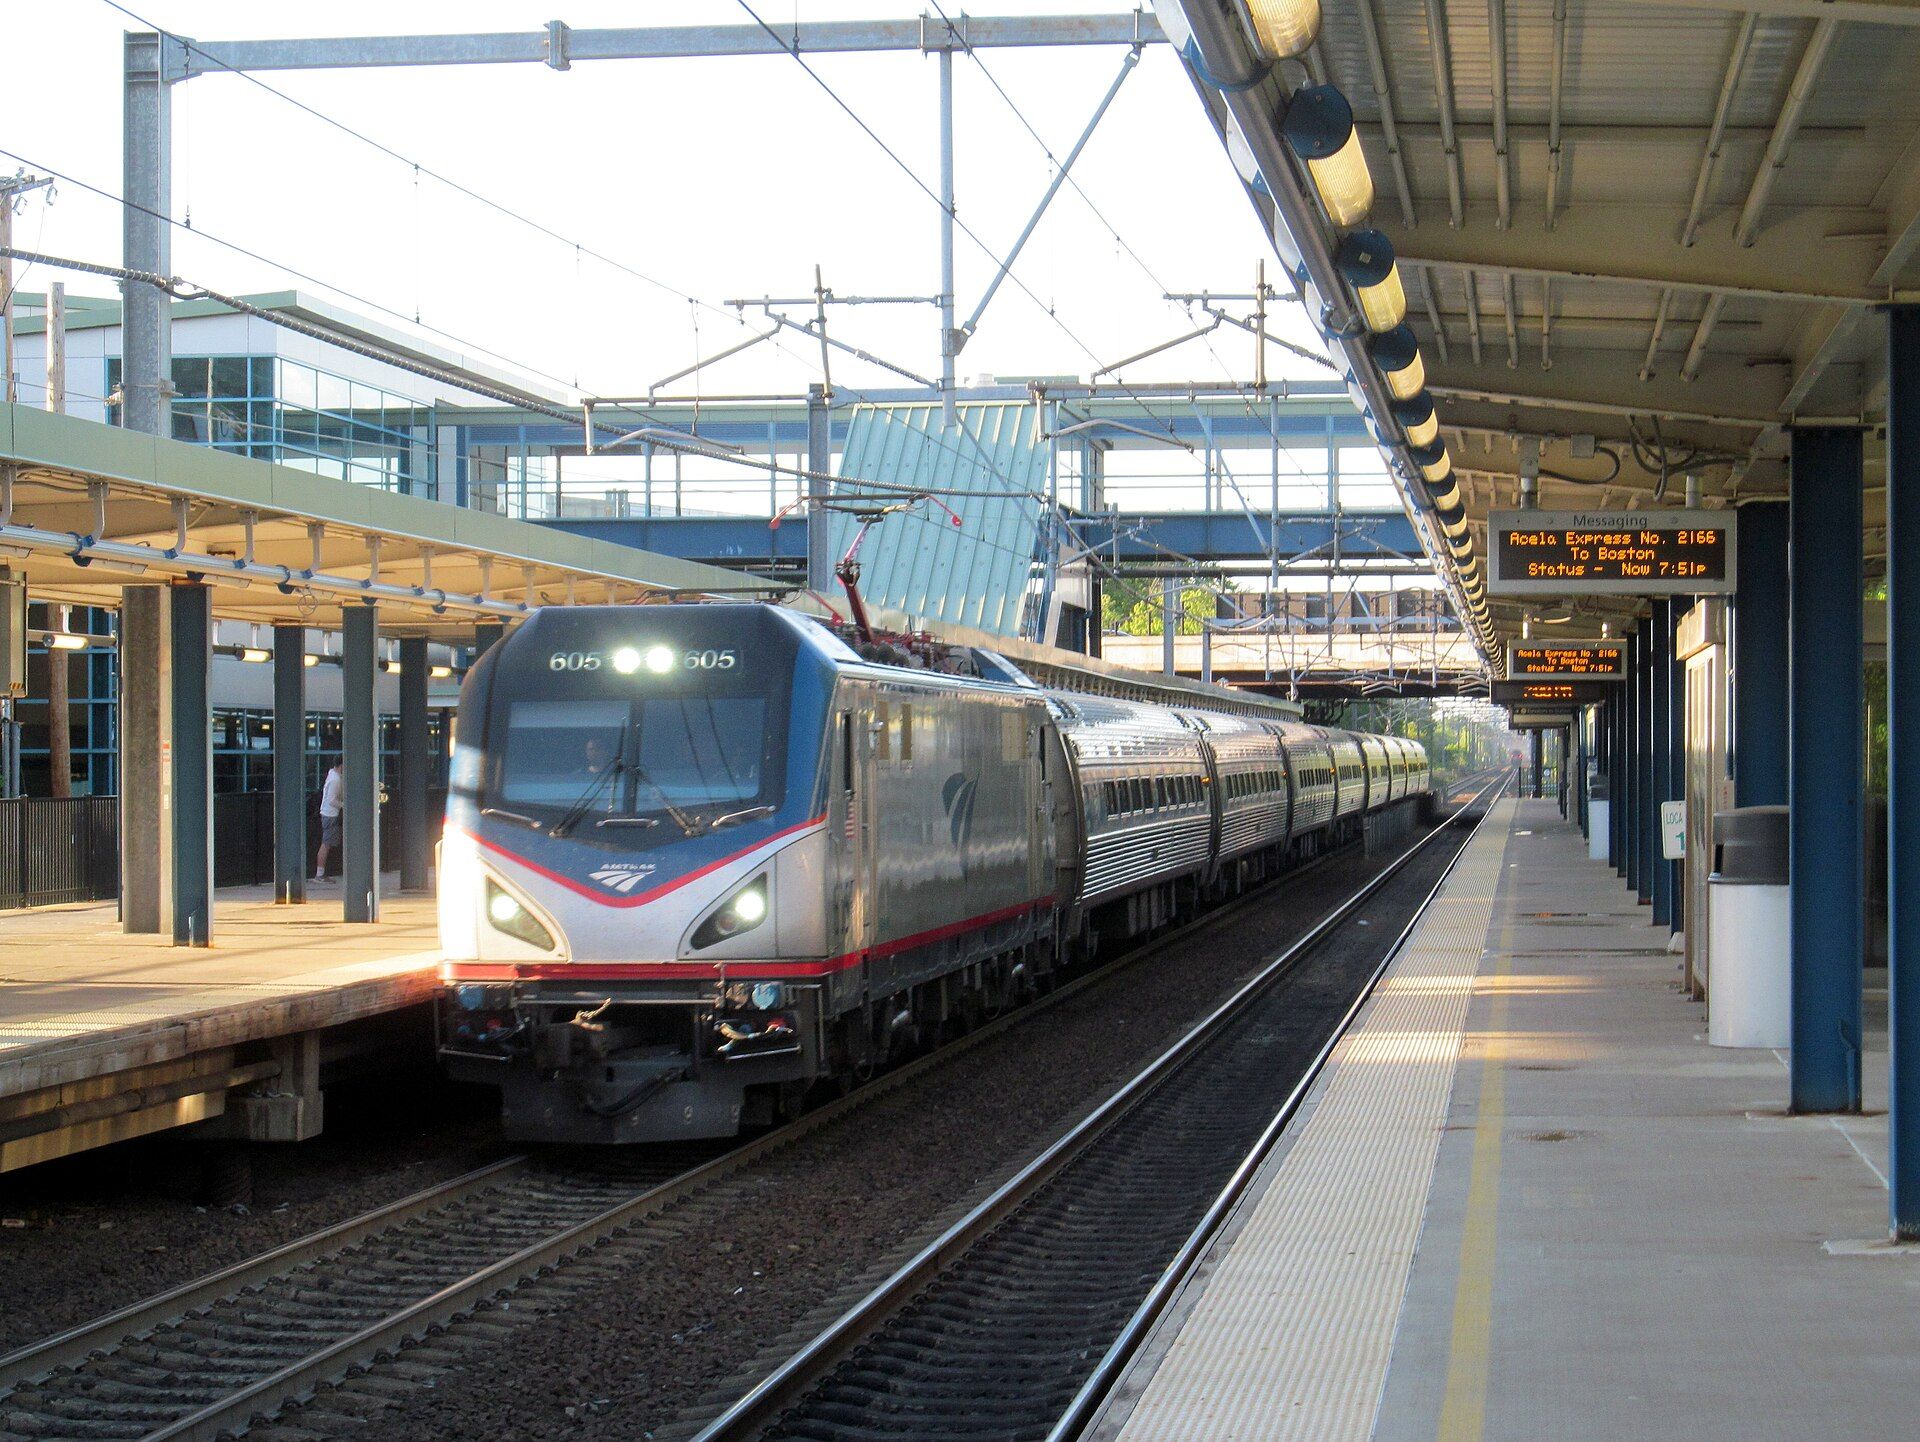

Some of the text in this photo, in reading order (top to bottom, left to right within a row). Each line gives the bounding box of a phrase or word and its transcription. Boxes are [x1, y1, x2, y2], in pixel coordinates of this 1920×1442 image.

[1573, 514, 1648, 529] Messaging
[1510, 531, 1716, 545] Acela Express No. 2166
[1571, 547, 1655, 560] To Boston
[1528, 563, 1585, 576] Status
[1621, 563, 1650, 576] Now
[1659, 562, 1706, 576] 7:51p
[684, 649, 735, 669] 605
[1545, 649, 1577, 657] Express
[549, 652, 601, 671] 605
